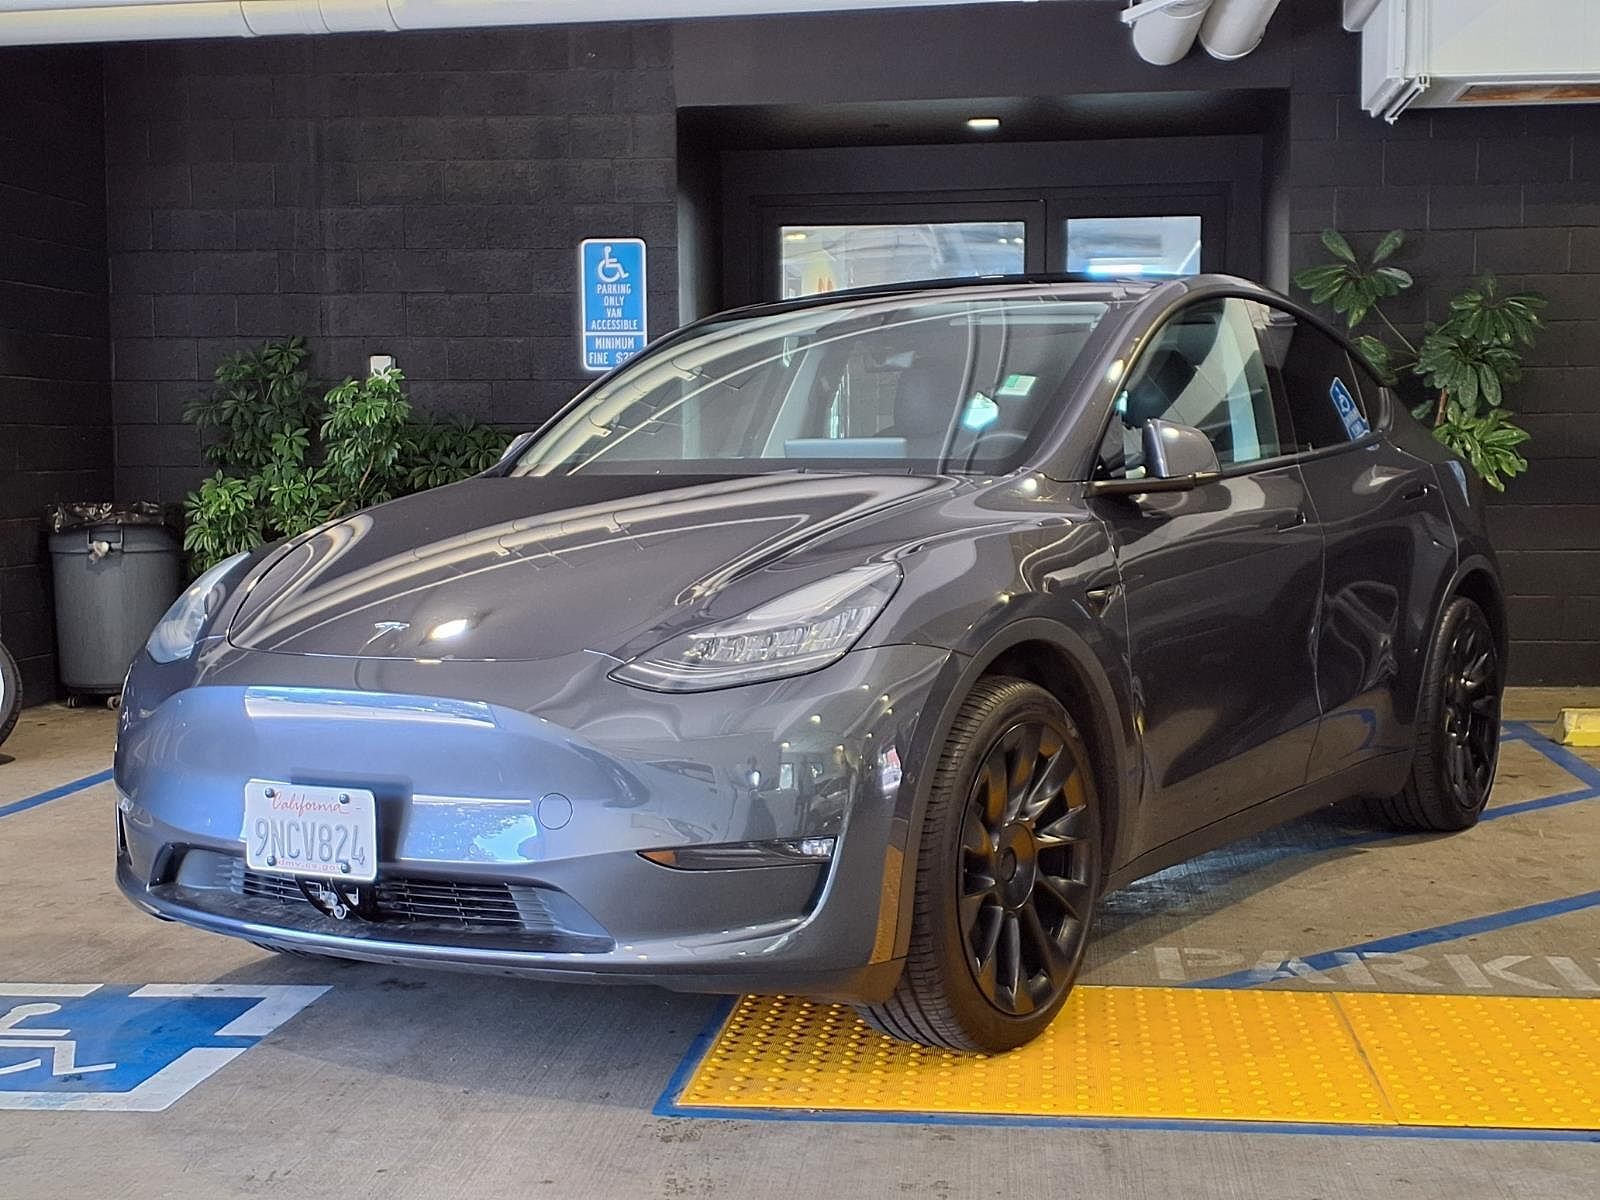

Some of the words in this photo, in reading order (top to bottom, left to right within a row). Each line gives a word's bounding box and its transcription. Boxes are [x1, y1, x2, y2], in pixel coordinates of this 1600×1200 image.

[596, 283, 631, 295] PARKING
[603, 295, 625, 306] ONLY
[606, 307, 622, 318] VAN
[591, 319, 638, 330] ACCESSIBLE
[595, 337, 635, 350] MINIMUM
[589, 352, 609, 365] FINE
[615, 351, 635, 364] $2
[271, 791, 349, 817] California
[255, 817, 366, 866] 9NCV824
[1153, 947, 1600, 991] PARKI
